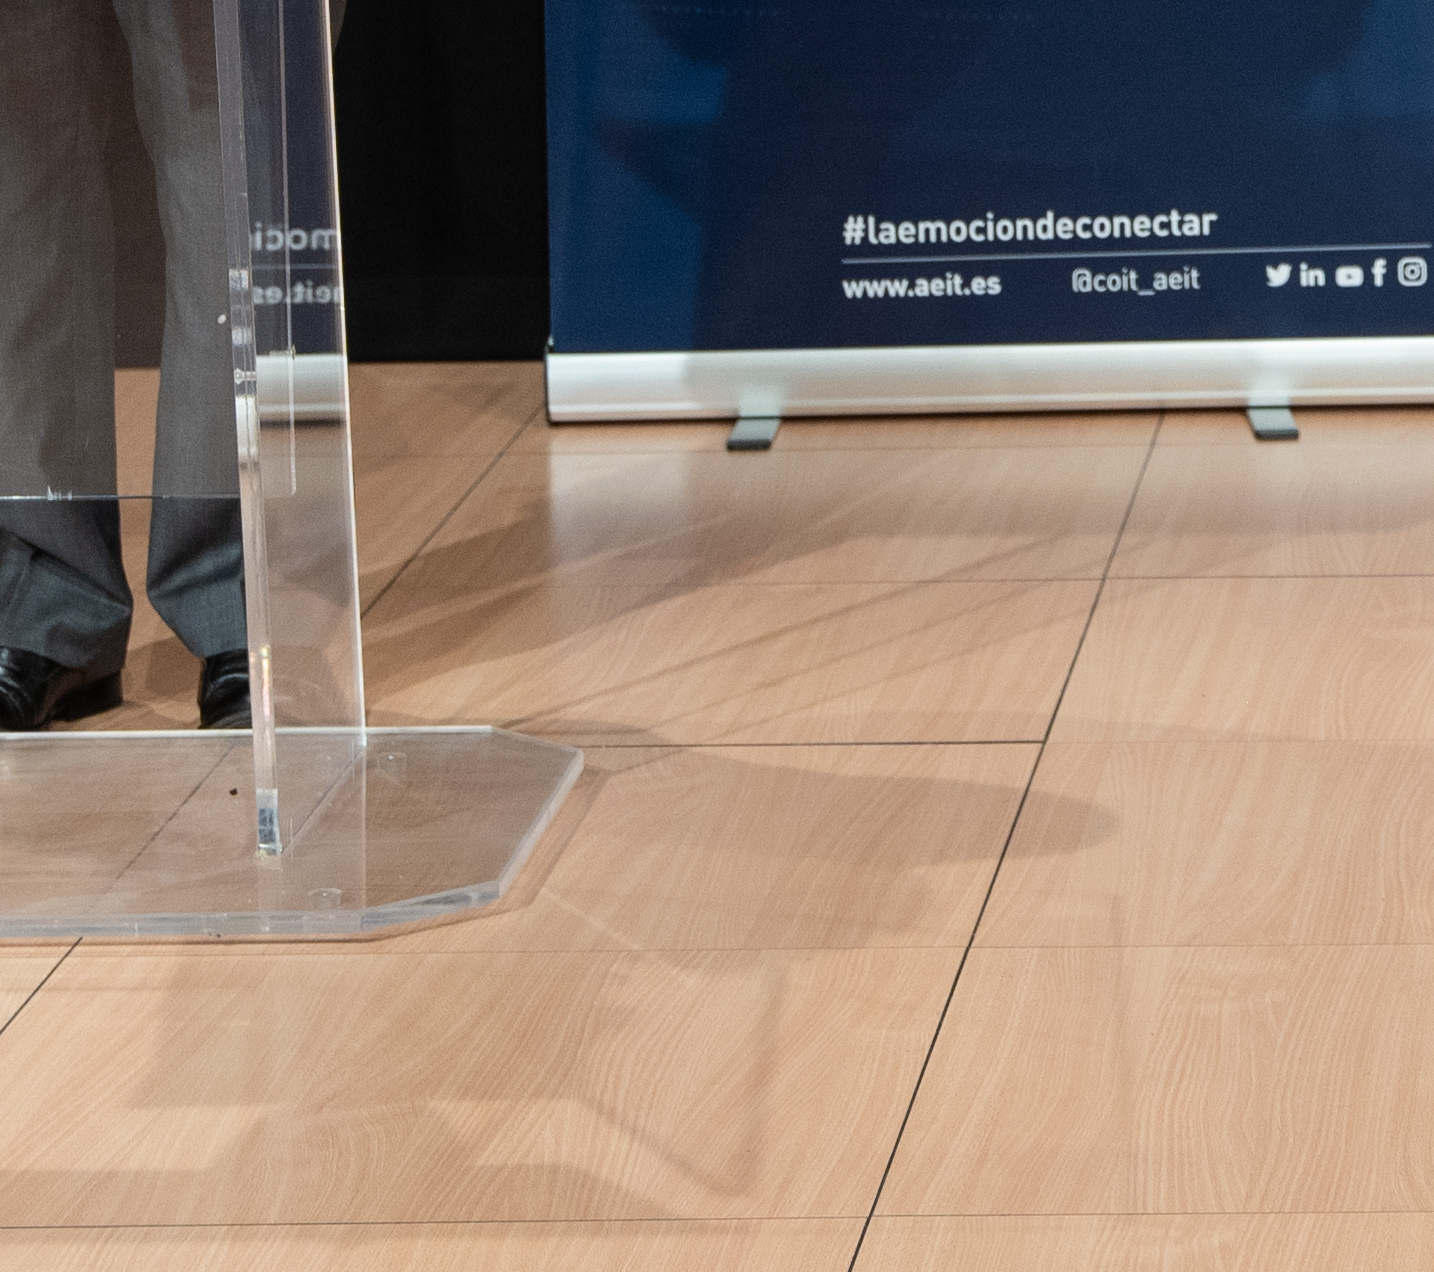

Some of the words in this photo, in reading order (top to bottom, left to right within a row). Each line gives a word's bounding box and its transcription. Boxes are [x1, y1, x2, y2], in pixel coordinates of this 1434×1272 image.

[842, 210, 1217, 247] #laemociondeconectar
[842, 272, 1002, 299] www.aeit.es
[1072, 266, 1201, 296] @coit_aeit
